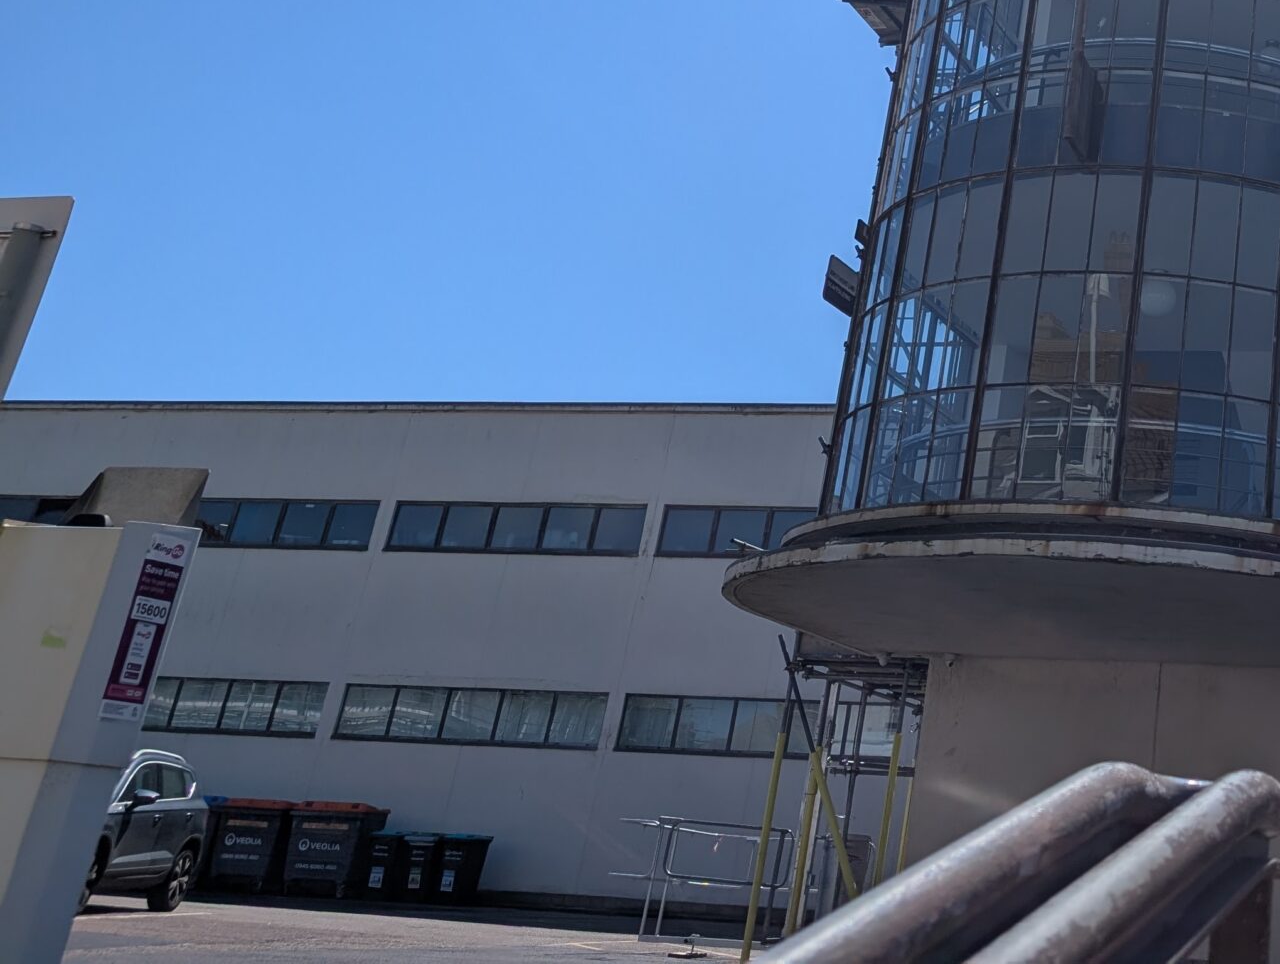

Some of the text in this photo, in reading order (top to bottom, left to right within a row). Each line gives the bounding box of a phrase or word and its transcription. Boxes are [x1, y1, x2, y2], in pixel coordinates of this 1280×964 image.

[136, 603, 168, 618] 15600
[236, 836, 262, 845] VEOLIA
[310, 842, 340, 851] VEOLIA
